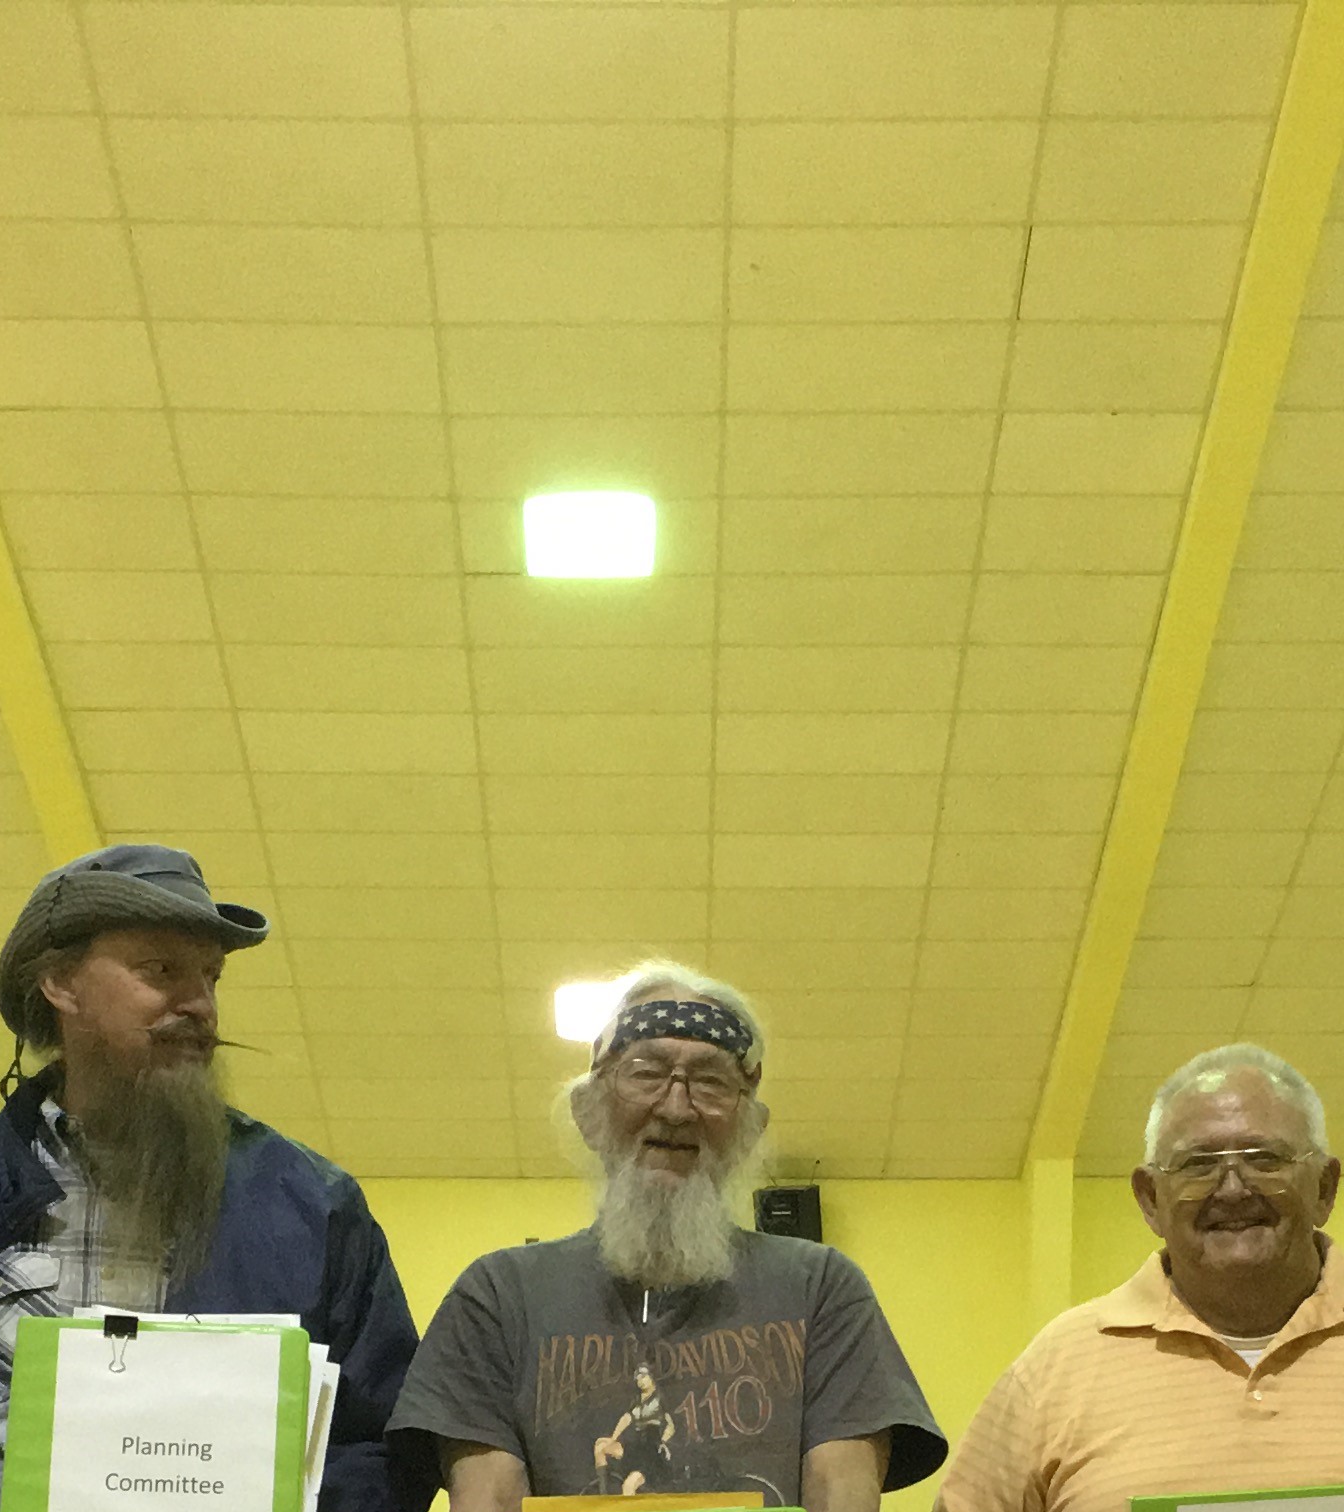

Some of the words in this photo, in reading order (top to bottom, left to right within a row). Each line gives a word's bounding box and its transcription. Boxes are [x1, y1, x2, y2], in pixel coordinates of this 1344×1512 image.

[534, 1332, 644, 1437] HARL
[674, 1374, 773, 1446] 110
[121, 1436, 213, 1462] Planning
[105, 1472, 225, 1495] Committee
